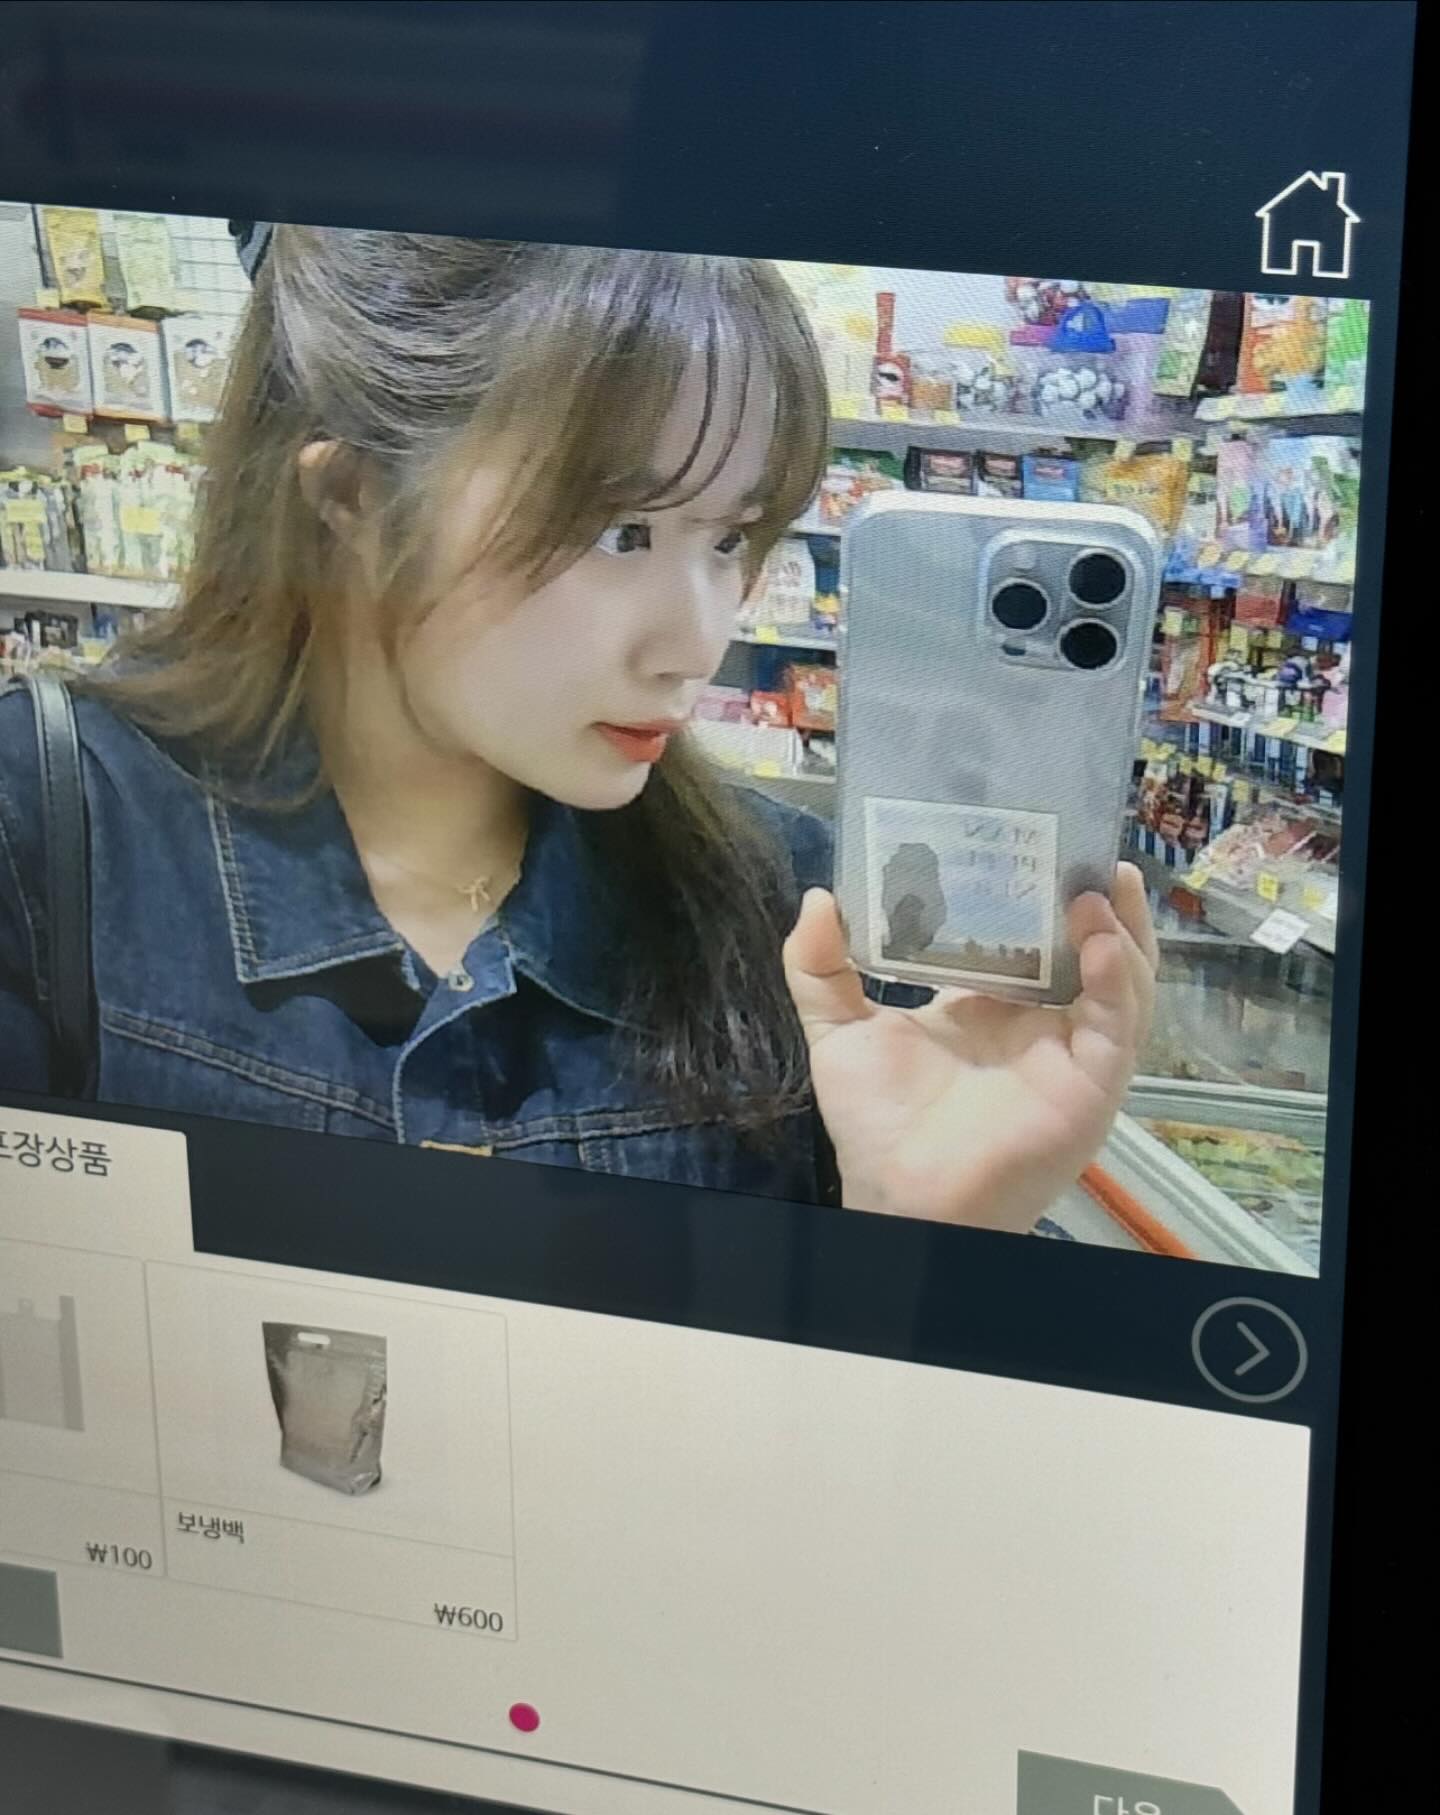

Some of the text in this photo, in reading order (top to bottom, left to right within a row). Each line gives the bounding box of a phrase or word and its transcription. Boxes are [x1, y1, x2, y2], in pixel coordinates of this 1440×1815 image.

[176, 1512, 244, 1544] 보냉백
[86, 1541, 152, 1569] ₩100
[433, 1602, 503, 1632] ₩600
